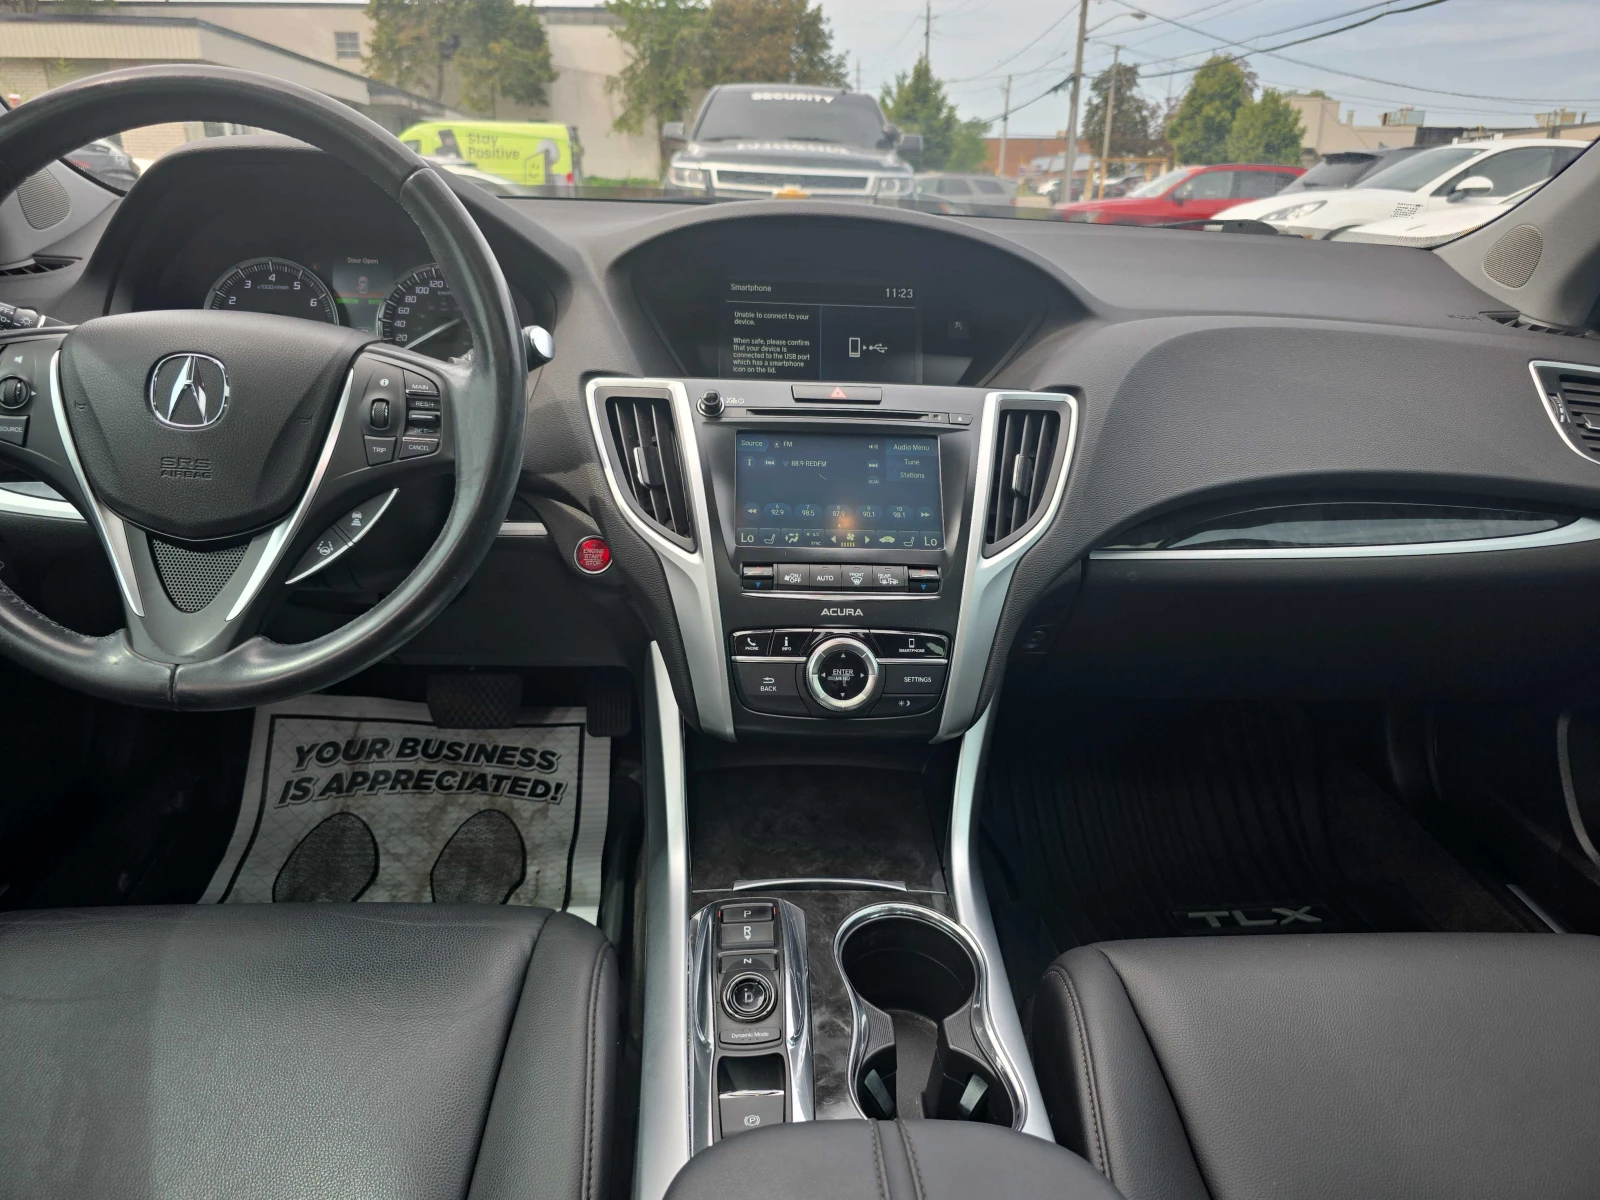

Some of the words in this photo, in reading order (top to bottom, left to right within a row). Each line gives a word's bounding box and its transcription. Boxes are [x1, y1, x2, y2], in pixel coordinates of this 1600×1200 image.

[751, 91, 835, 104] SECURITY
[468, 133, 498, 146] Stay
[468, 146, 520, 160] Positive
[362, 257, 379, 265] Open
[268, 273, 276, 282] 4
[244, 280, 252, 289] 3
[293, 281, 301, 290] 5
[429, 280, 444, 288] 120
[730, 283, 772, 292] Smartphone
[415, 286, 430, 295] 100
[885, 288, 914, 298] 11:23
[228, 296, 237, 305] 2
[310, 298, 318, 307] 6
[404, 295, 417, 303] 80
[397, 307, 410, 315] 60
[394, 319, 406, 328] 40
[395, 333, 408, 341] 20
[733, 337, 751, 345] When
[751, 338, 766, 346] safe,
[733, 351, 765, 359] connected
[767, 366, 777, 374] lid.
[741, 439, 763, 447] Source
[912, 444, 930, 452] Menu
[160, 456, 212, 468] SRS
[805, 460, 827, 468] REDFM
[904, 458, 920, 466] Tune
[160, 469, 212, 480] AIRBAG
[899, 471, 925, 479] Stations
[741, 533, 755, 543] Lo
[924, 536, 938, 546] Lo
[820, 607, 864, 616] ACURA
[292, 737, 391, 772] YOUR
[394, 736, 560, 772] BUSINESS
[275, 775, 318, 808] IS
[315, 768, 568, 804] APPRECIATED!
[743, 910, 752, 918] P
[1187, 906, 1322, 928] TLX
[743, 925, 752, 936] R
[744, 991, 754, 1003] D
[731, 1032, 753, 1040] Dynamic
